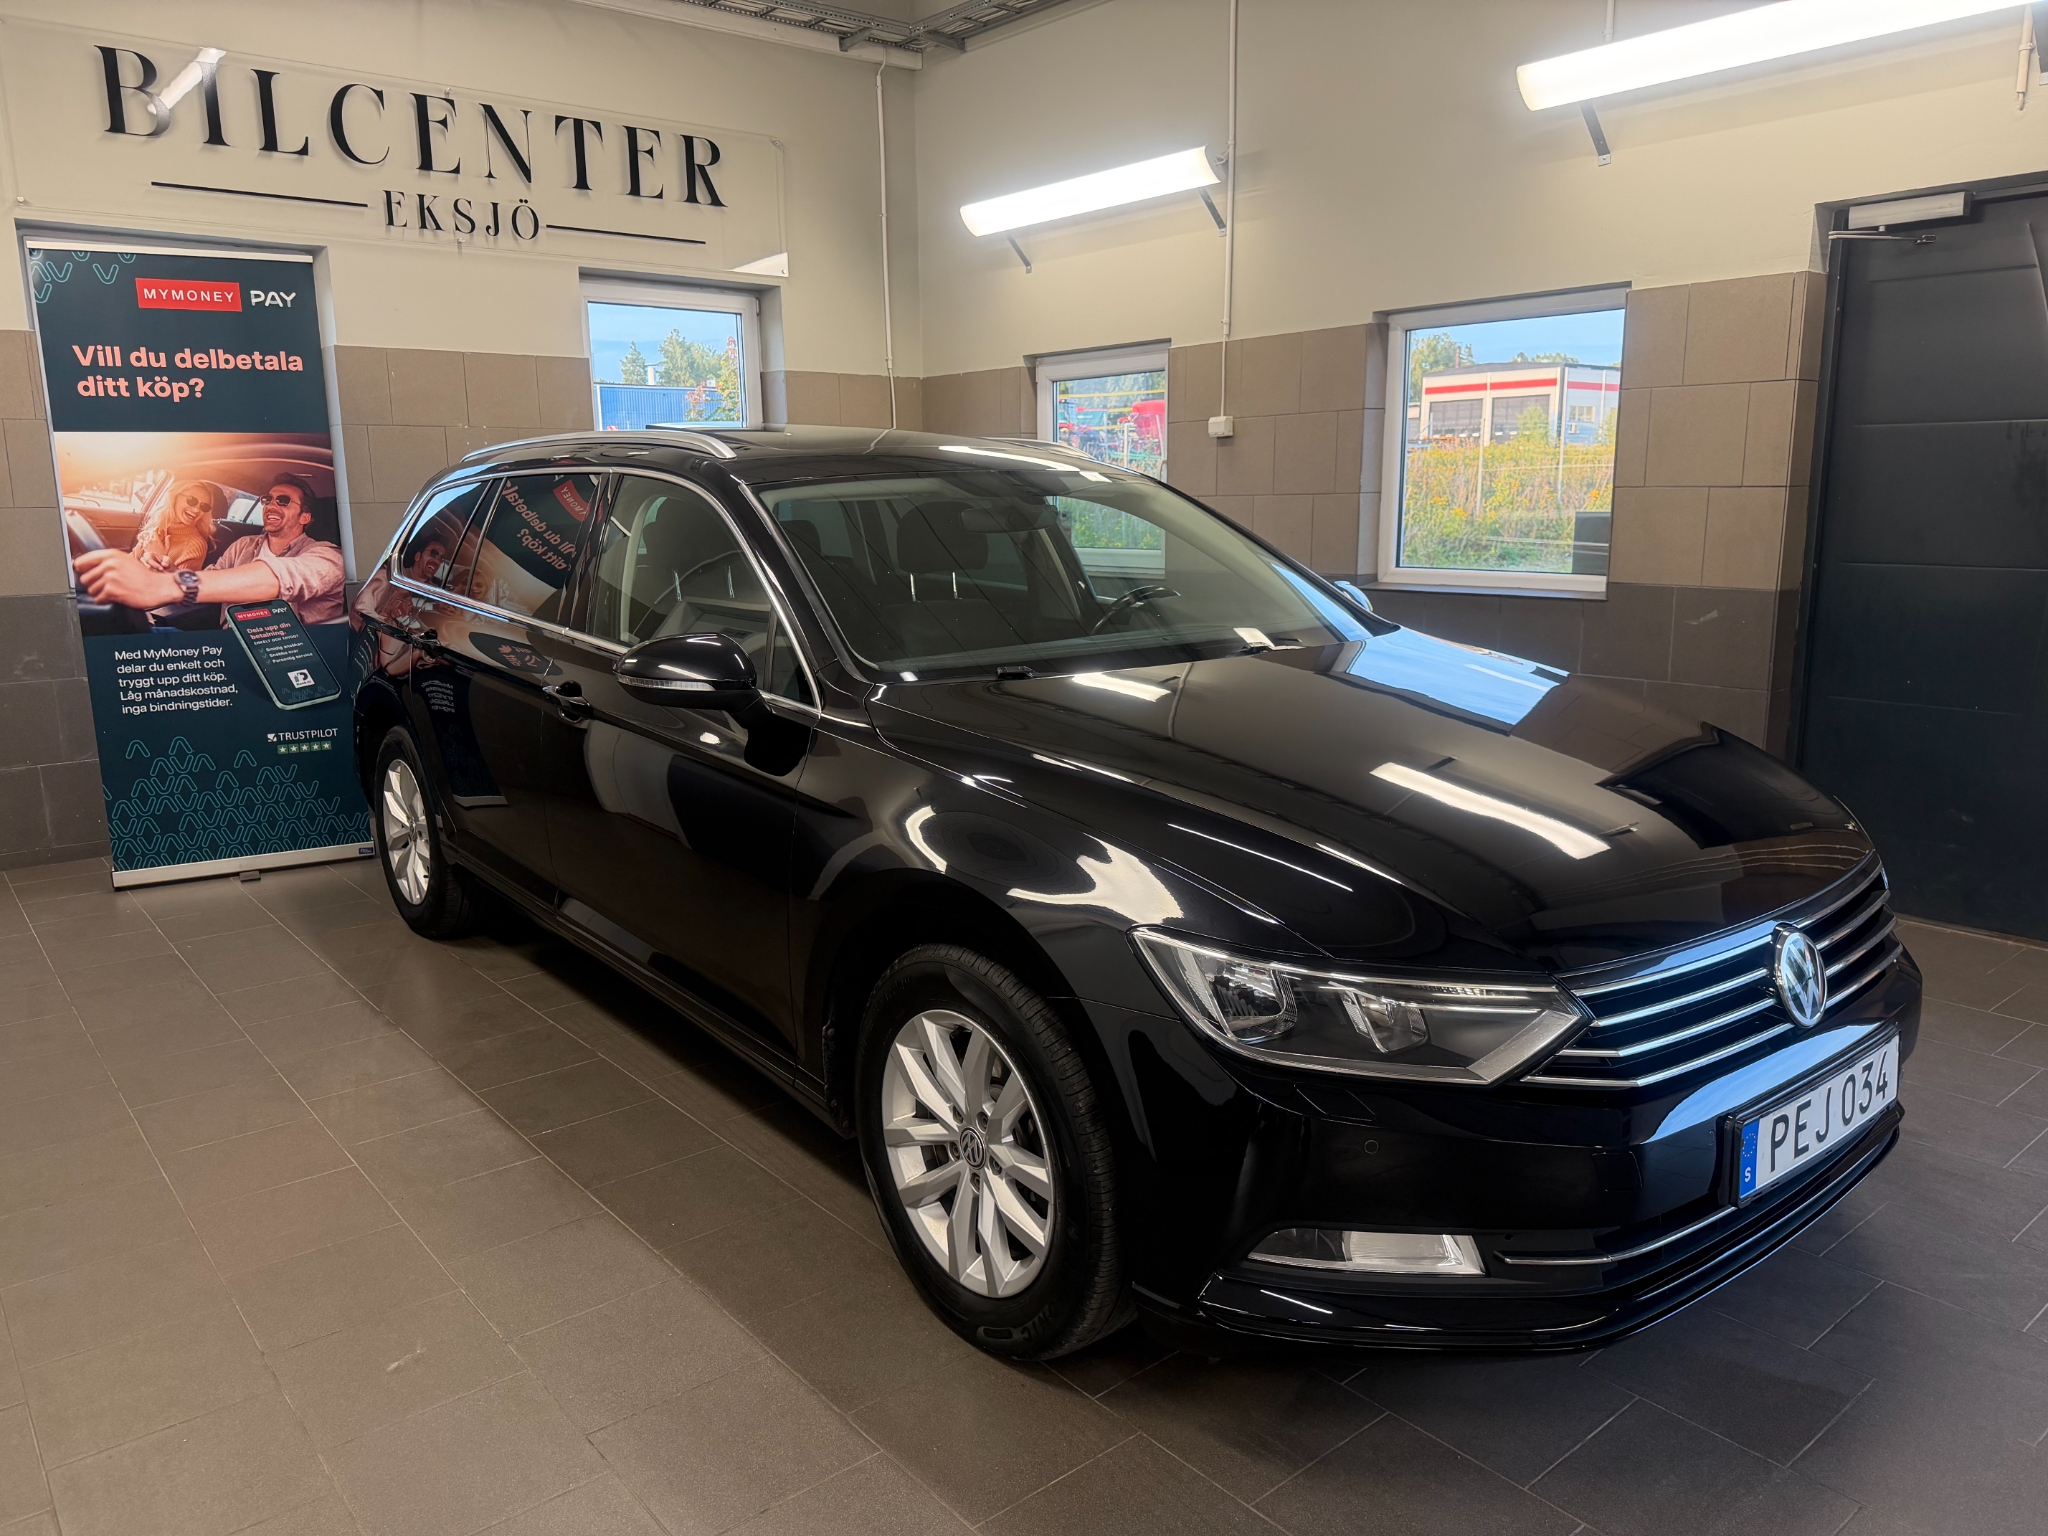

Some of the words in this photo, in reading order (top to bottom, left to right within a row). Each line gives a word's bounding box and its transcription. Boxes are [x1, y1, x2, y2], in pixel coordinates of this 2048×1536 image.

[94, 45, 728, 207] BILCENTER
[383, 190, 540, 240] EKSJÖ
[143, 288, 234, 303] MYMONEY
[250, 290, 296, 308] PAY
[72, 344, 122, 367] Vill
[129, 347, 167, 368] du
[174, 348, 304, 372] delbetala
[77, 375, 130, 397] ditt
[136, 376, 205, 403] köp?
[115, 650, 141, 660] Med
[144, 648, 200, 660] MyMoney
[202, 646, 223, 656] Pay
[117, 664, 146, 674] delar
[149, 662, 165, 672] du
[167, 660, 201, 671] enkelt
[204, 659, 225, 668] och
[118, 676, 155, 688] tryggt
[157, 676, 180, 686] upp
[182, 673, 201, 683] ditt
[203, 671, 227, 682] köp.
[120, 690, 142, 701] Låg
[144, 684, 238, 699] månadskostnad,
[122, 704, 147, 715] inga
[149, 698, 233, 712] bindningstider.
[278, 728, 338, 741] TRUSTPILOT
[1770, 1086, 1831, 1172] PEJ
[1841, 1050, 1888, 1127] 034
[1744, 1166, 1751, 1183] S
